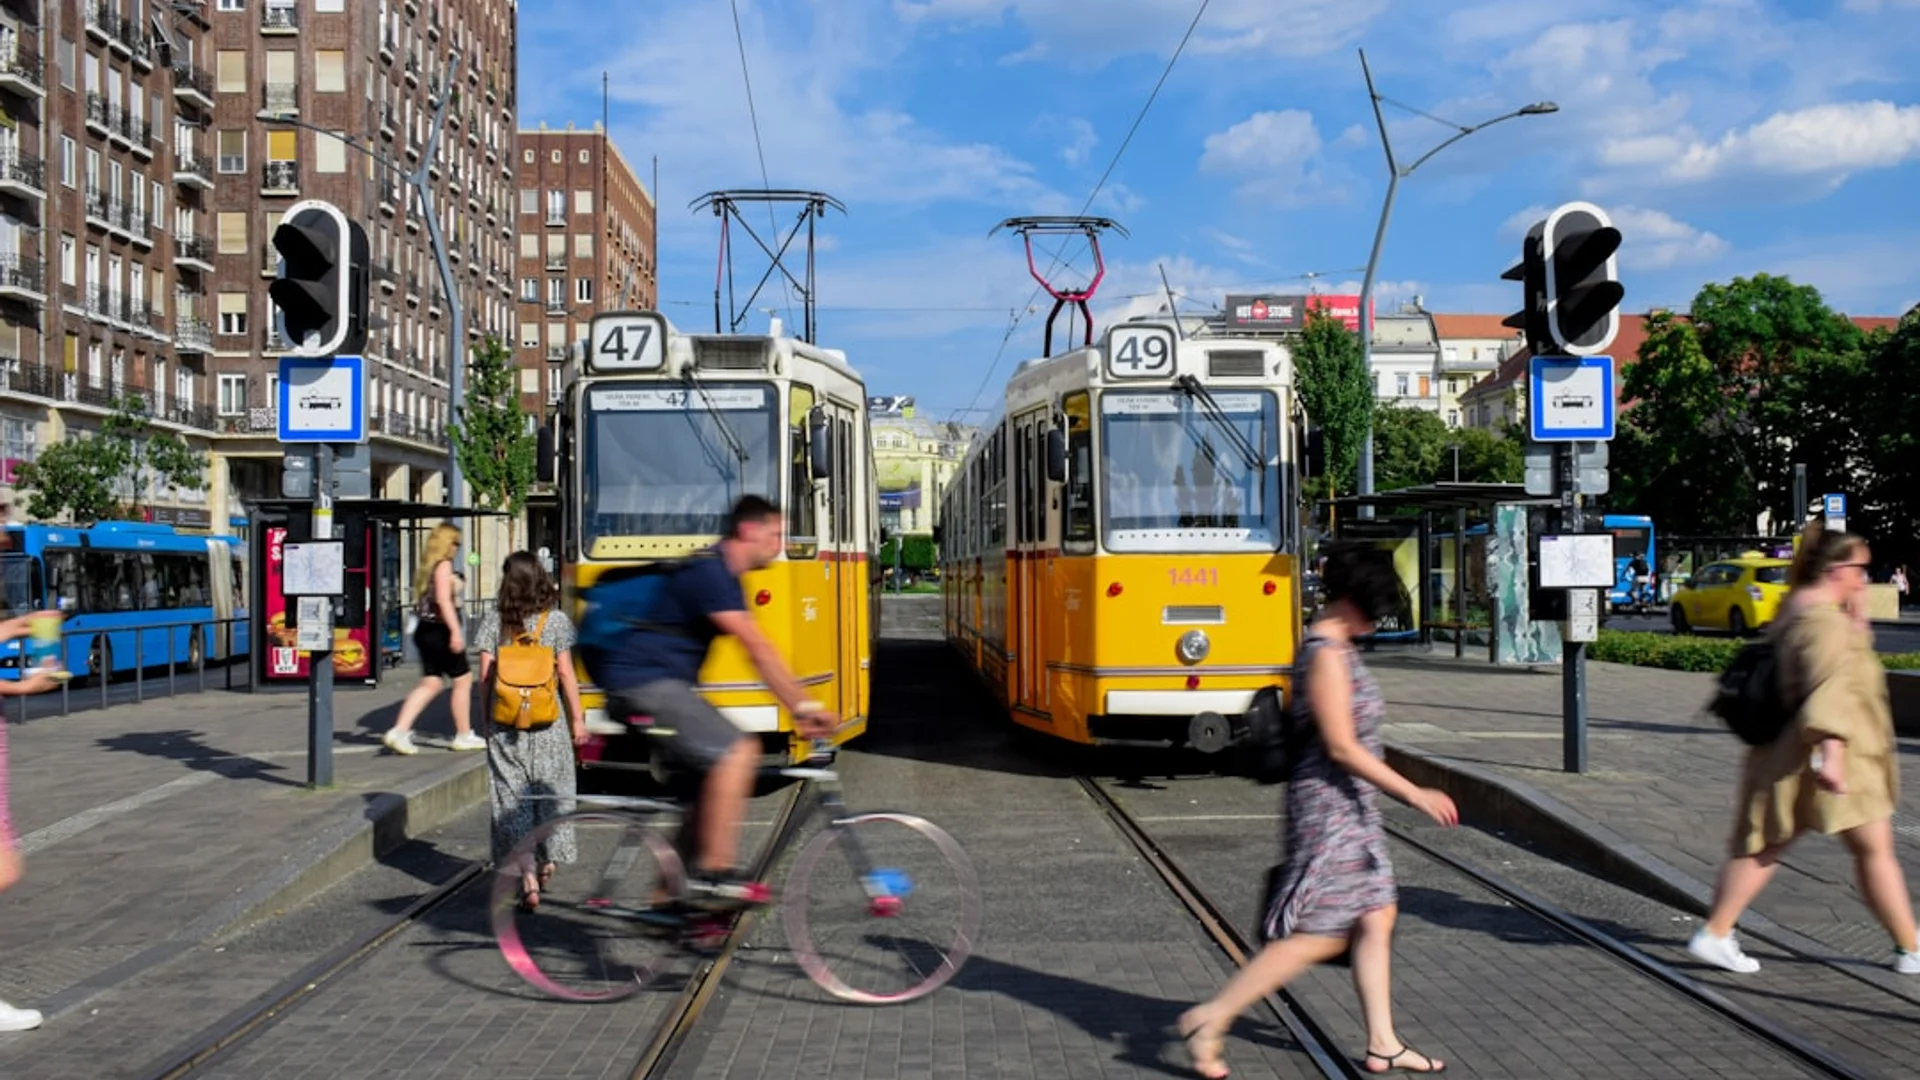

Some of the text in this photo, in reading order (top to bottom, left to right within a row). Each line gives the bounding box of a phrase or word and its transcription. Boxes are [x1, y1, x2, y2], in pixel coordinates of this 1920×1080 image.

[600, 325, 652, 361] 47
[1115, 335, 1168, 370] 49
[666, 392, 688, 407] 47
[1168, 567, 1219, 586] 1441
